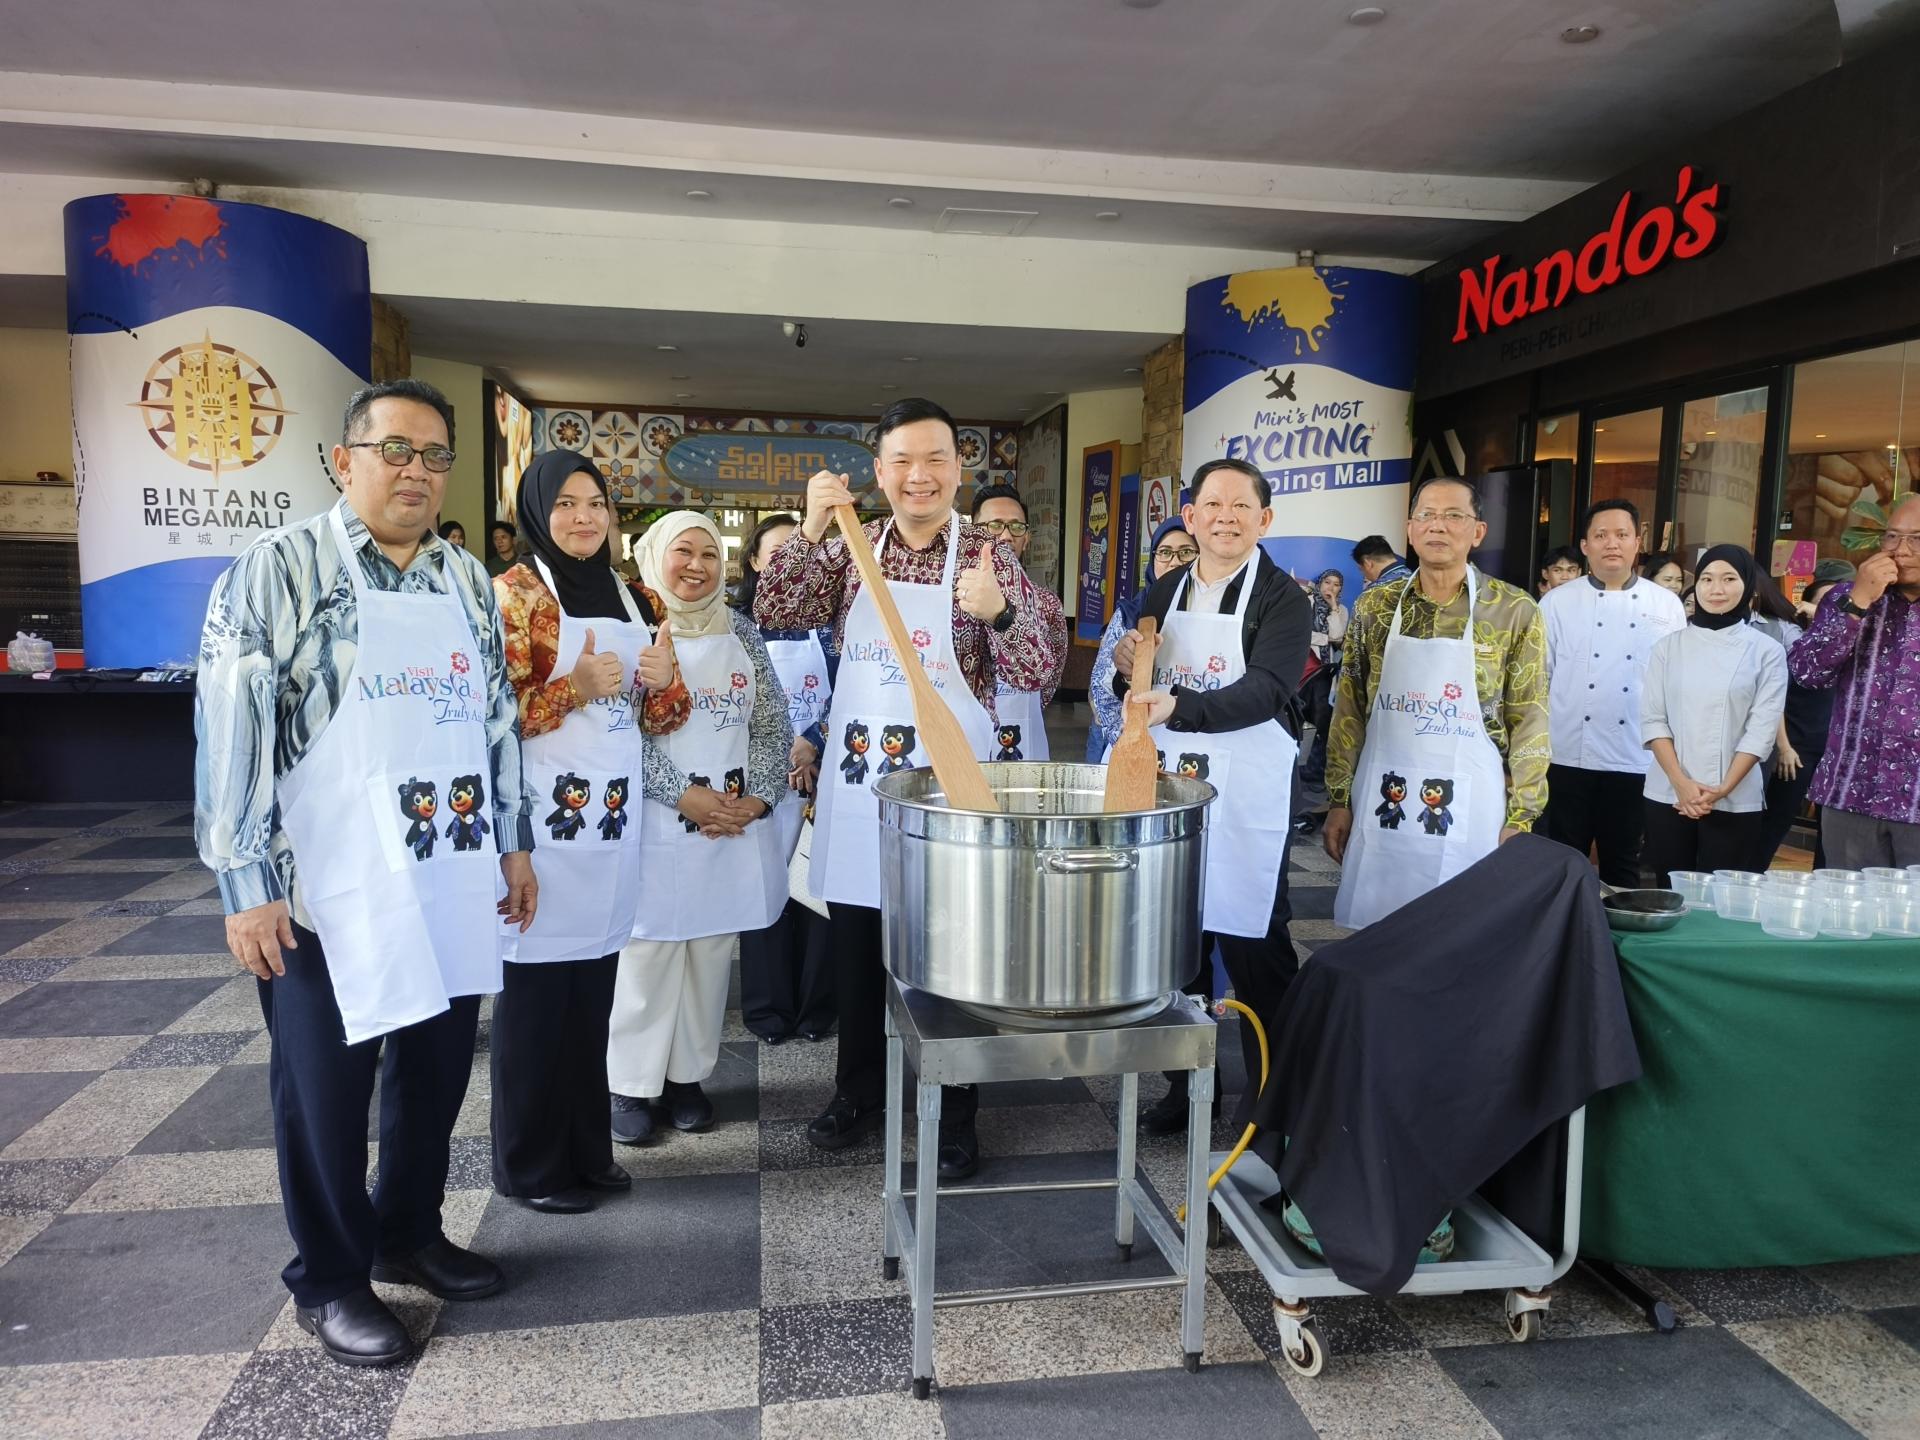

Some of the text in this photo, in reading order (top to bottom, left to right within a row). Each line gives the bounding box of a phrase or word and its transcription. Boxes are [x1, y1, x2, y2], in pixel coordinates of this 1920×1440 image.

[1452, 165, 1719, 343] Nando's
[1254, 400, 1364, 429] Miri's MOST
[1226, 422, 1372, 465] EXCITING
[1267, 461, 1382, 493] ping Mall
[143, 487, 291, 510] BINTANG
[406, 666, 434, 677] Visit
[1175, 664, 1193, 673] Visit
[358, 672, 471, 701] Malaysia
[697, 687, 716, 695] Visit
[1407, 691, 1426, 700] Visit
[691, 691, 746, 714] laysia
[1415, 716, 1476, 738] Truly Asia
